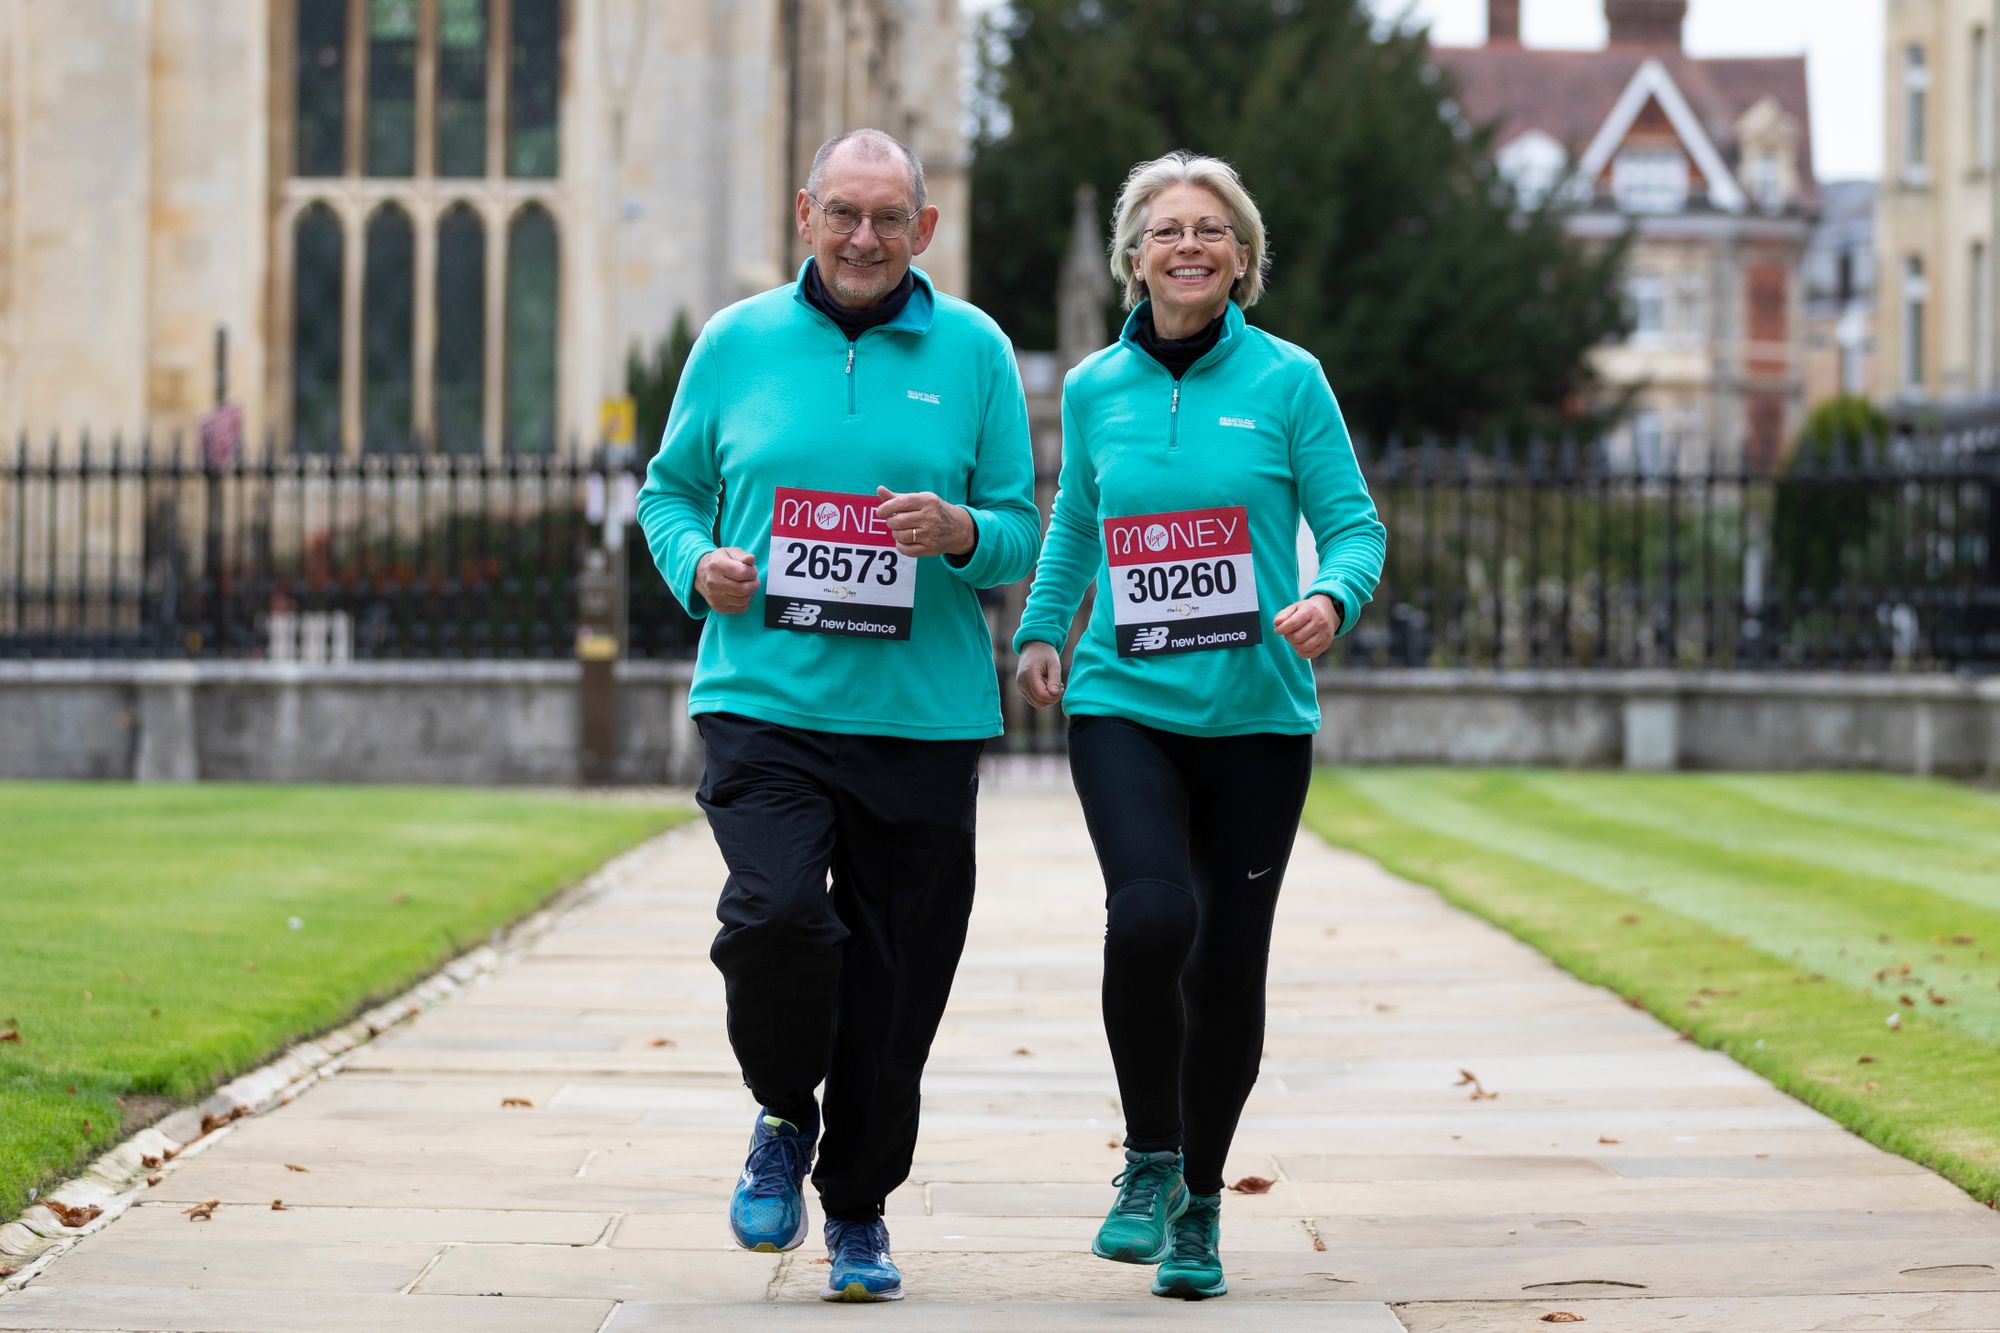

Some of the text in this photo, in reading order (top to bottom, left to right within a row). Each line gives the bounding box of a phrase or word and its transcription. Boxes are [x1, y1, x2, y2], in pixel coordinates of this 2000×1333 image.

[780, 498, 888, 535] MONE
[1112, 516, 1238, 555] MONEY
[785, 542, 898, 586] 26573
[1126, 559, 1237, 604] 30260
[821, 619, 845, 630] new
[847, 619, 897, 634] balance
[1171, 637, 1196, 649] new
[1198, 630, 1248, 646] balance
